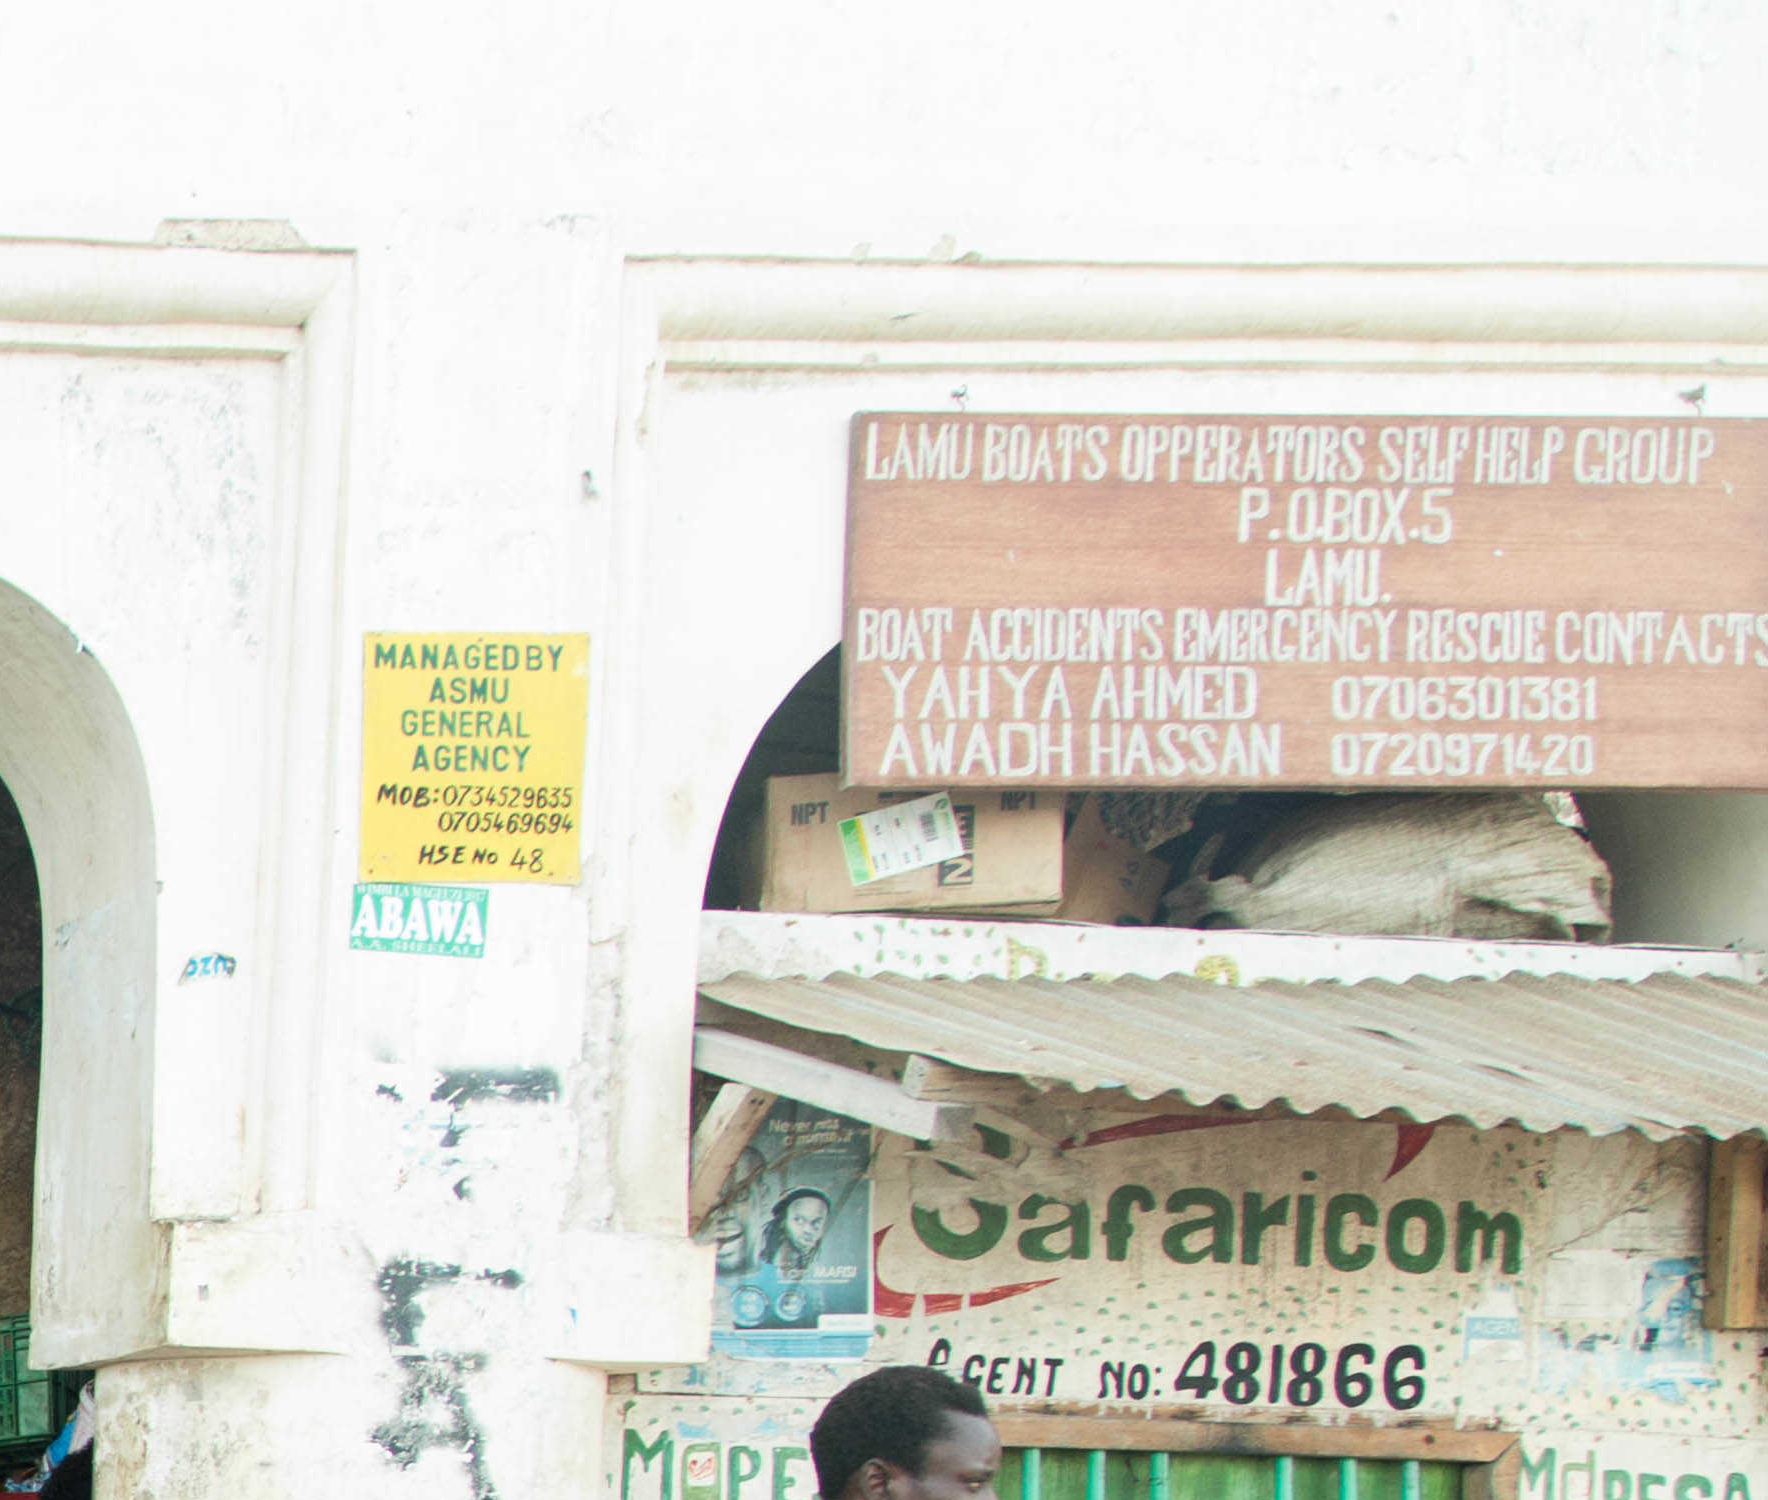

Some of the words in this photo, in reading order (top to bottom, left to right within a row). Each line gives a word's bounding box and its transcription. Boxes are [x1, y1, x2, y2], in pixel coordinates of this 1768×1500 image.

[865, 423, 972, 481] LAMU
[982, 423, 1108, 482] BOATS
[1121, 424, 1363, 484] OPPERATORS
[1376, 426, 1469, 485] SELF
[1472, 426, 1564, 485] HELP
[1573, 428, 1716, 486] GROUP
[856, 609, 952, 662] BOAT
[963, 608, 1163, 663] ACCIDENTS
[1173, 608, 1399, 663] EMERGENCY
[1407, 610, 1545, 664] RESCUE
[429, 677, 510, 704] ASMU
[881, 666, 1073, 721] YAHYA
[1089, 666, 1257, 720] AHMED
[1331, 675, 1598, 722] 0706301381
[400, 709, 531, 738] GENERAL
[412, 745, 531, 772] AGENCY
[878, 724, 1071, 777] AWADH
[1087, 724, 1282, 780] HASSAN
[1330, 733, 1595, 778] 0720971420
[437, 811, 573, 834] 0705469694
[791, 801, 829, 826] NPT
[418, 845, 465, 864] HSE
[510, 848, 544, 873] 48
[350, 892, 485, 945] ABAWA
[1175, 1341, 1427, 1411] 481866
